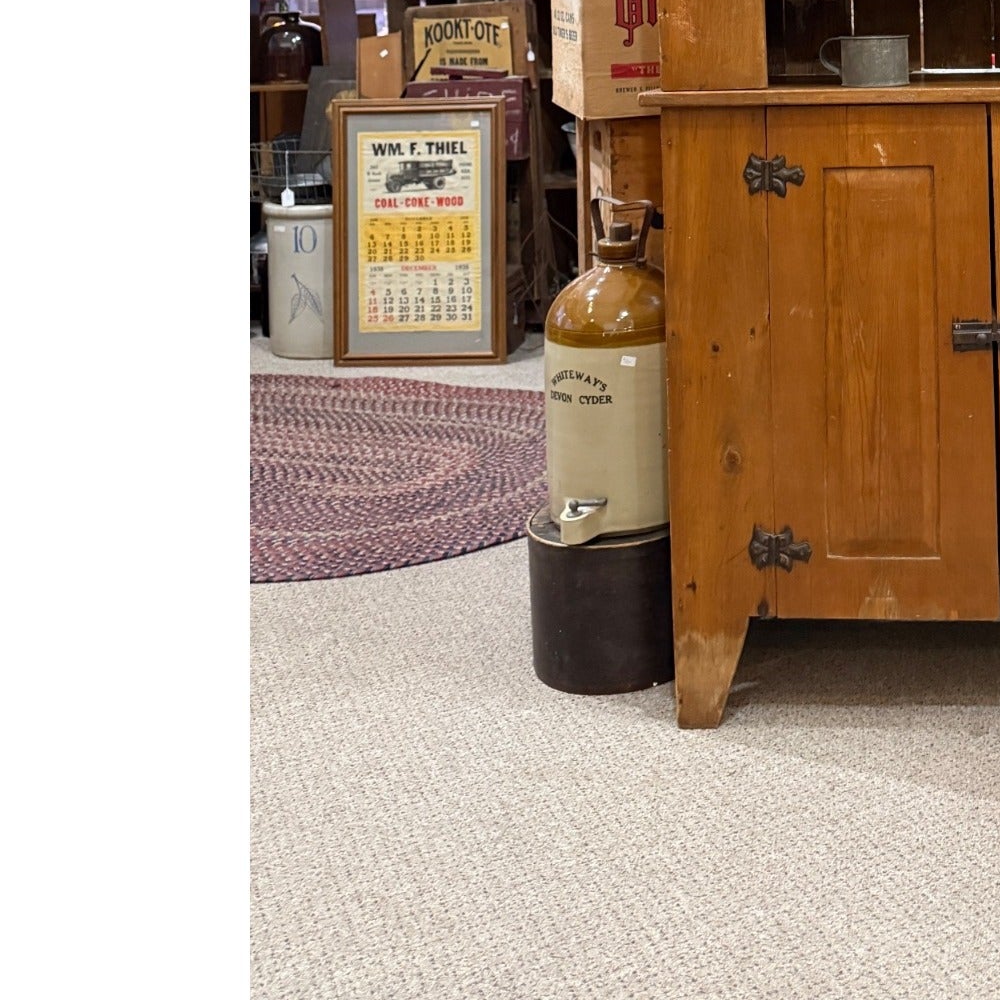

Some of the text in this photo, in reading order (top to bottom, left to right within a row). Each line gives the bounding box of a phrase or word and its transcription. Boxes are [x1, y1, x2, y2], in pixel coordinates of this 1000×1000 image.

[449, 58, 468, 66] MADE
[470, 58, 489, 66] FROM
[372, 141, 467, 156] WM. F. THIEL
[293, 224, 317, 254] 10
[383, 297, 394, 305] 12
[461, 313, 472, 321] 31
[551, 369, 608, 392] WHITEWAY'S
[550, 390, 613, 404] DEVON CYDER
